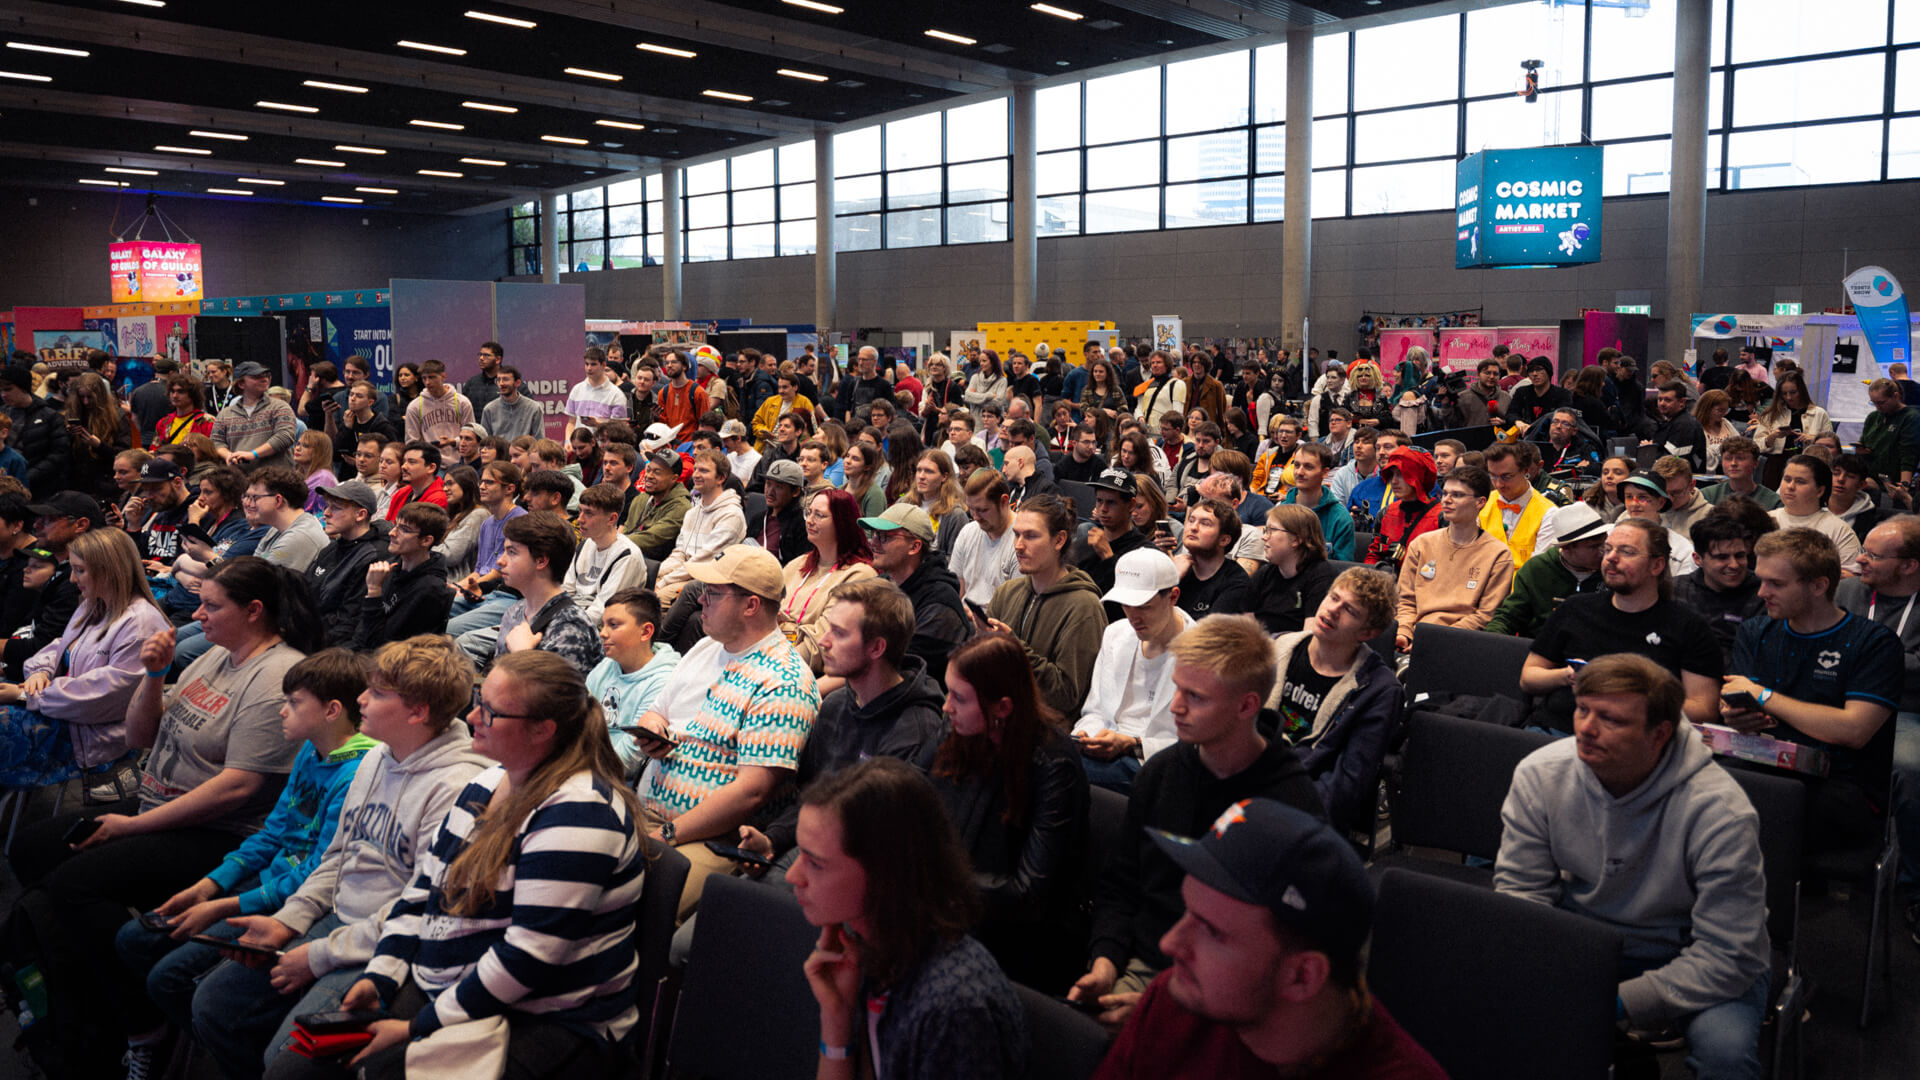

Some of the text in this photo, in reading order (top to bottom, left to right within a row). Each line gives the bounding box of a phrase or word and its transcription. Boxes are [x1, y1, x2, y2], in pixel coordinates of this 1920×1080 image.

[1458, 185, 1479, 207] COSMIC
[1496, 180, 1583, 198] COSMIC
[1458, 207, 1478, 227] MARKET
[1495, 202, 1582, 220] MARKET
[111, 250, 132, 260] GALAXY
[142, 249, 186, 260] GALAXY
[142, 261, 200, 272] OF GUILDS
[354, 329, 371, 340] START
[372, 329, 387, 340] INTO
[40, 346, 96, 361] LEIF'
[48, 360, 90, 369] ADVENTUR
[525, 380, 568, 395] NDIE
